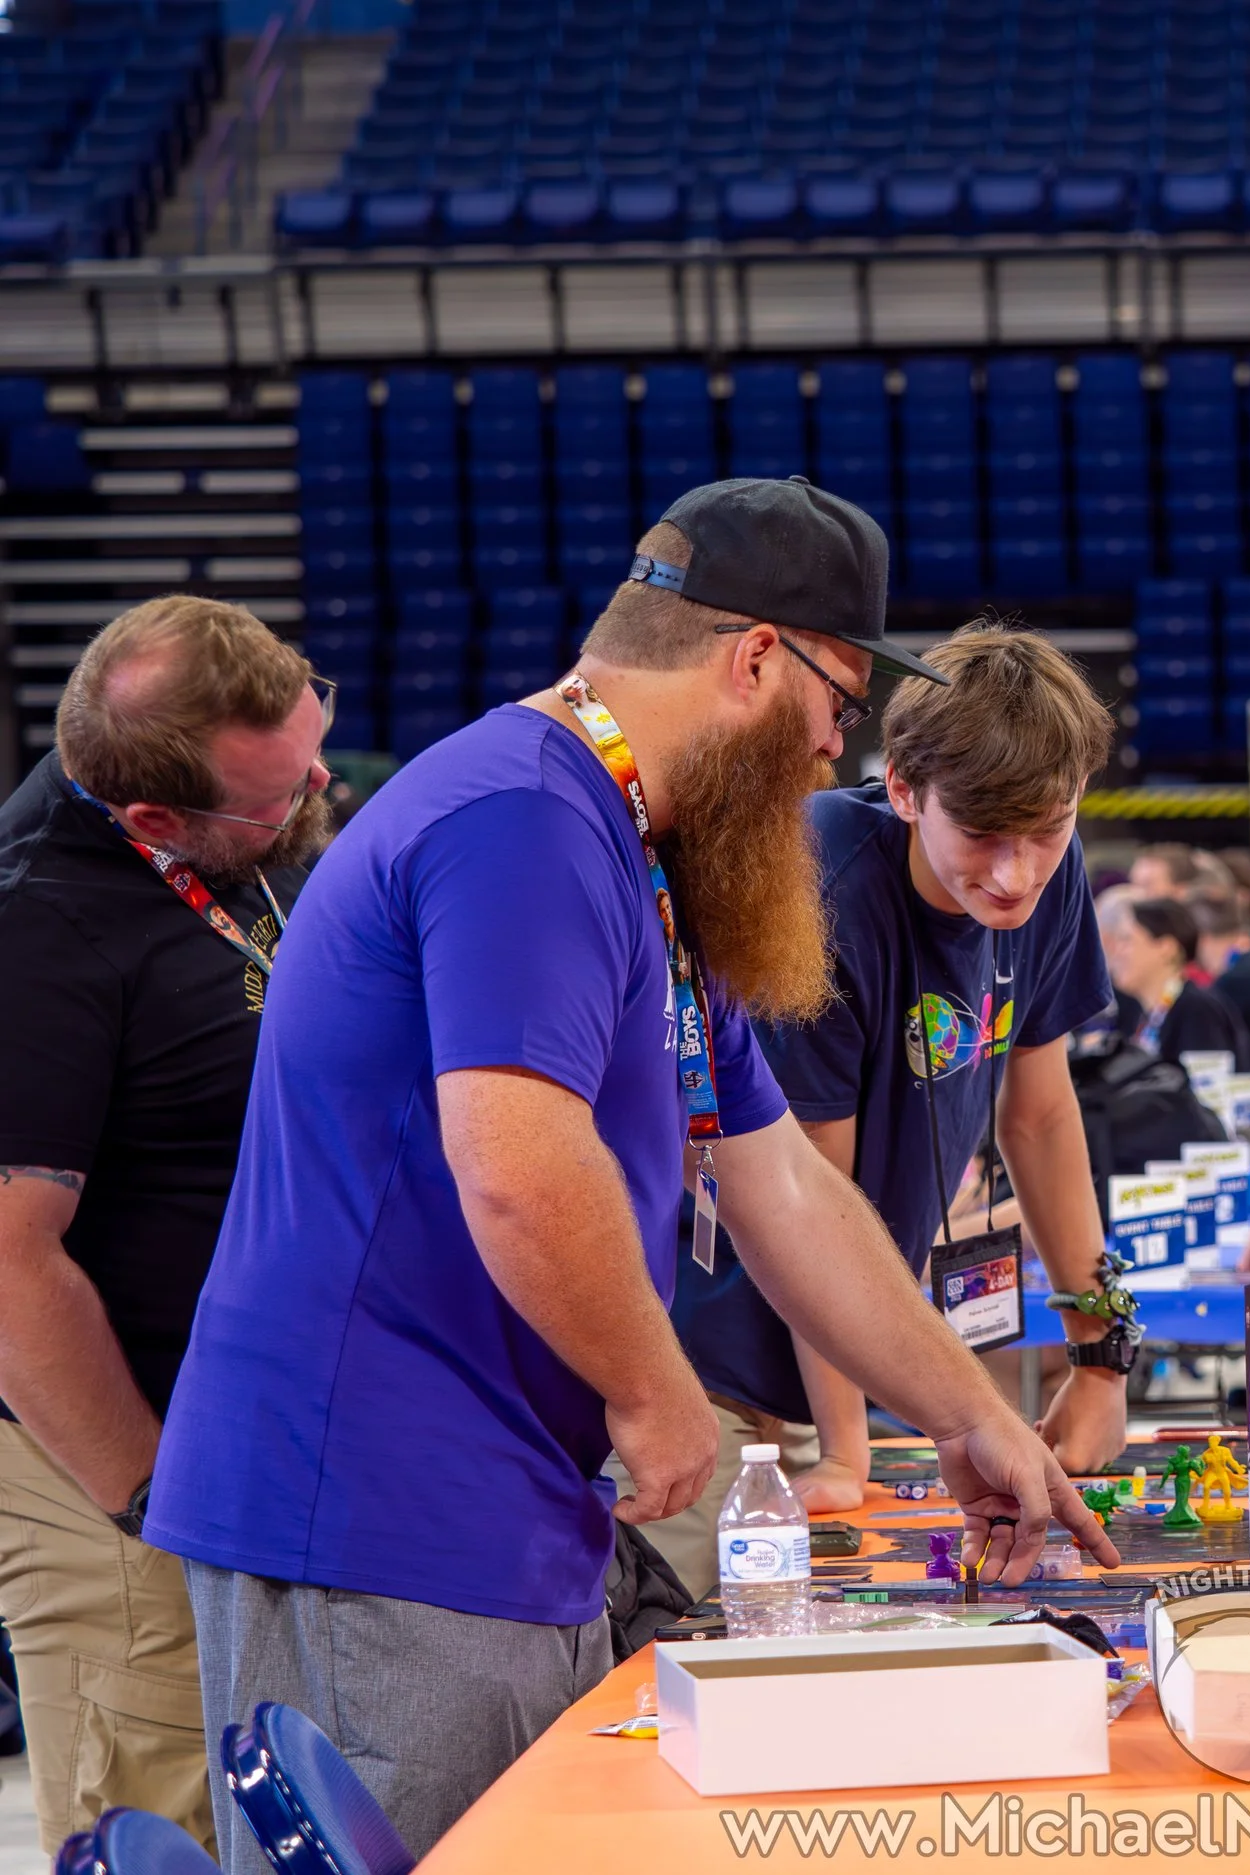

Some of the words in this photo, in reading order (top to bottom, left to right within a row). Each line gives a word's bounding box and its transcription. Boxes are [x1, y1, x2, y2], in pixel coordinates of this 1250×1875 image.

[627, 780, 650, 832] BOYS
[244, 960, 265, 1014] MIDD
[679, 1041, 689, 1061] THE
[681, 1005, 702, 1057] BOYS
[745, 1555, 776, 1563] Drinking
